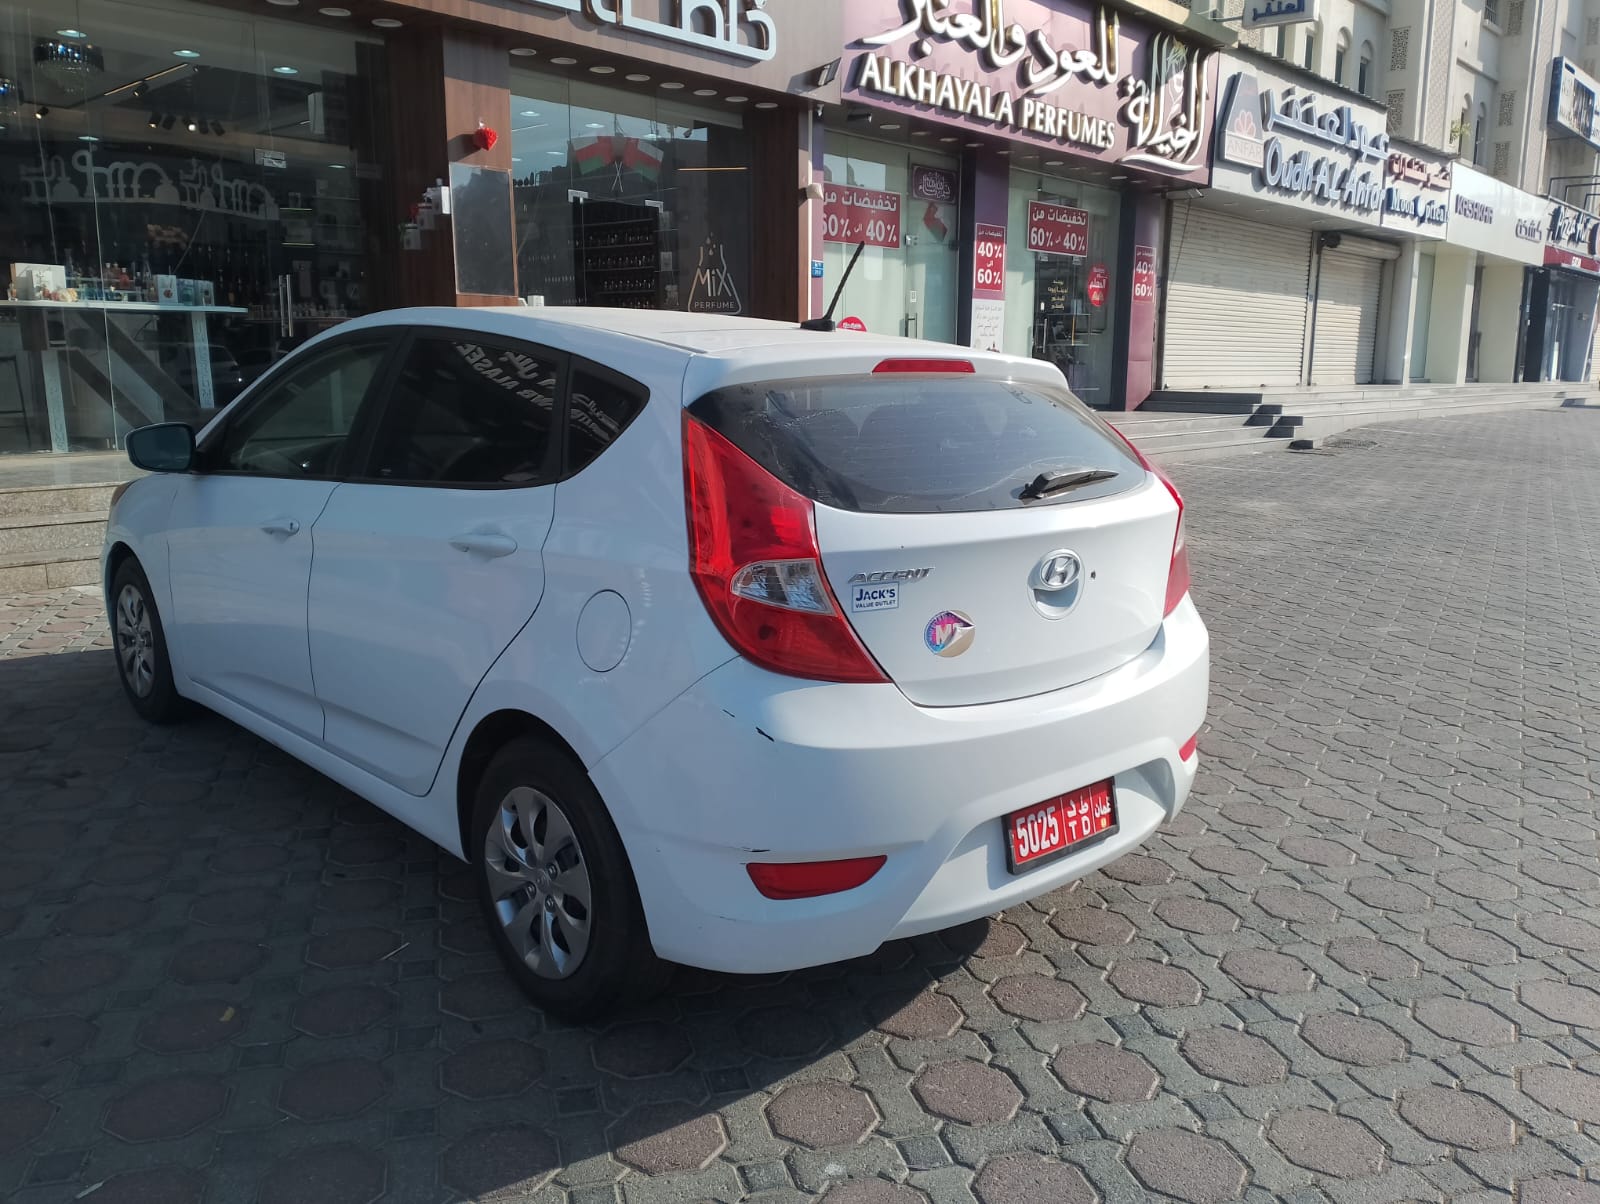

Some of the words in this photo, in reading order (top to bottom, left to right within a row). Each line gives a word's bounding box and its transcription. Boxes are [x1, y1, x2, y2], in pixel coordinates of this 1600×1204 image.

[1029, 5, 1119, 94] للعود
[860, 53, 1014, 124] ALKHAYALA
[1024, 99, 1115, 150] PERFUMES
[1228, 139, 1262, 162] ANFAR
[1266, 136, 1313, 191] Oudh
[842, 190, 897, 214] تخفيضات
[1390, 186, 1415, 215] Moon
[1455, 194, 1494, 224] KASHKHA
[1033, 207, 1045, 221] من
[1048, 208, 1086, 227] تخفيضات
[866, 219, 897, 243] 40%
[1031, 227, 1053, 248] 60%
[977, 242, 1002, 259] 40%
[1063, 232, 1085, 251] 40%
[977, 269, 1002, 284] 60%
[1136, 261, 1155, 276] 40%
[1135, 283, 1153, 297] 60%
[694, 301, 735, 309] PERFUME
[848, 567, 936, 584] ACCENT
[856, 588, 896, 602] JACK'S
[875, 599, 896, 607] OUTLET
[1016, 806, 1060, 858] 5025
